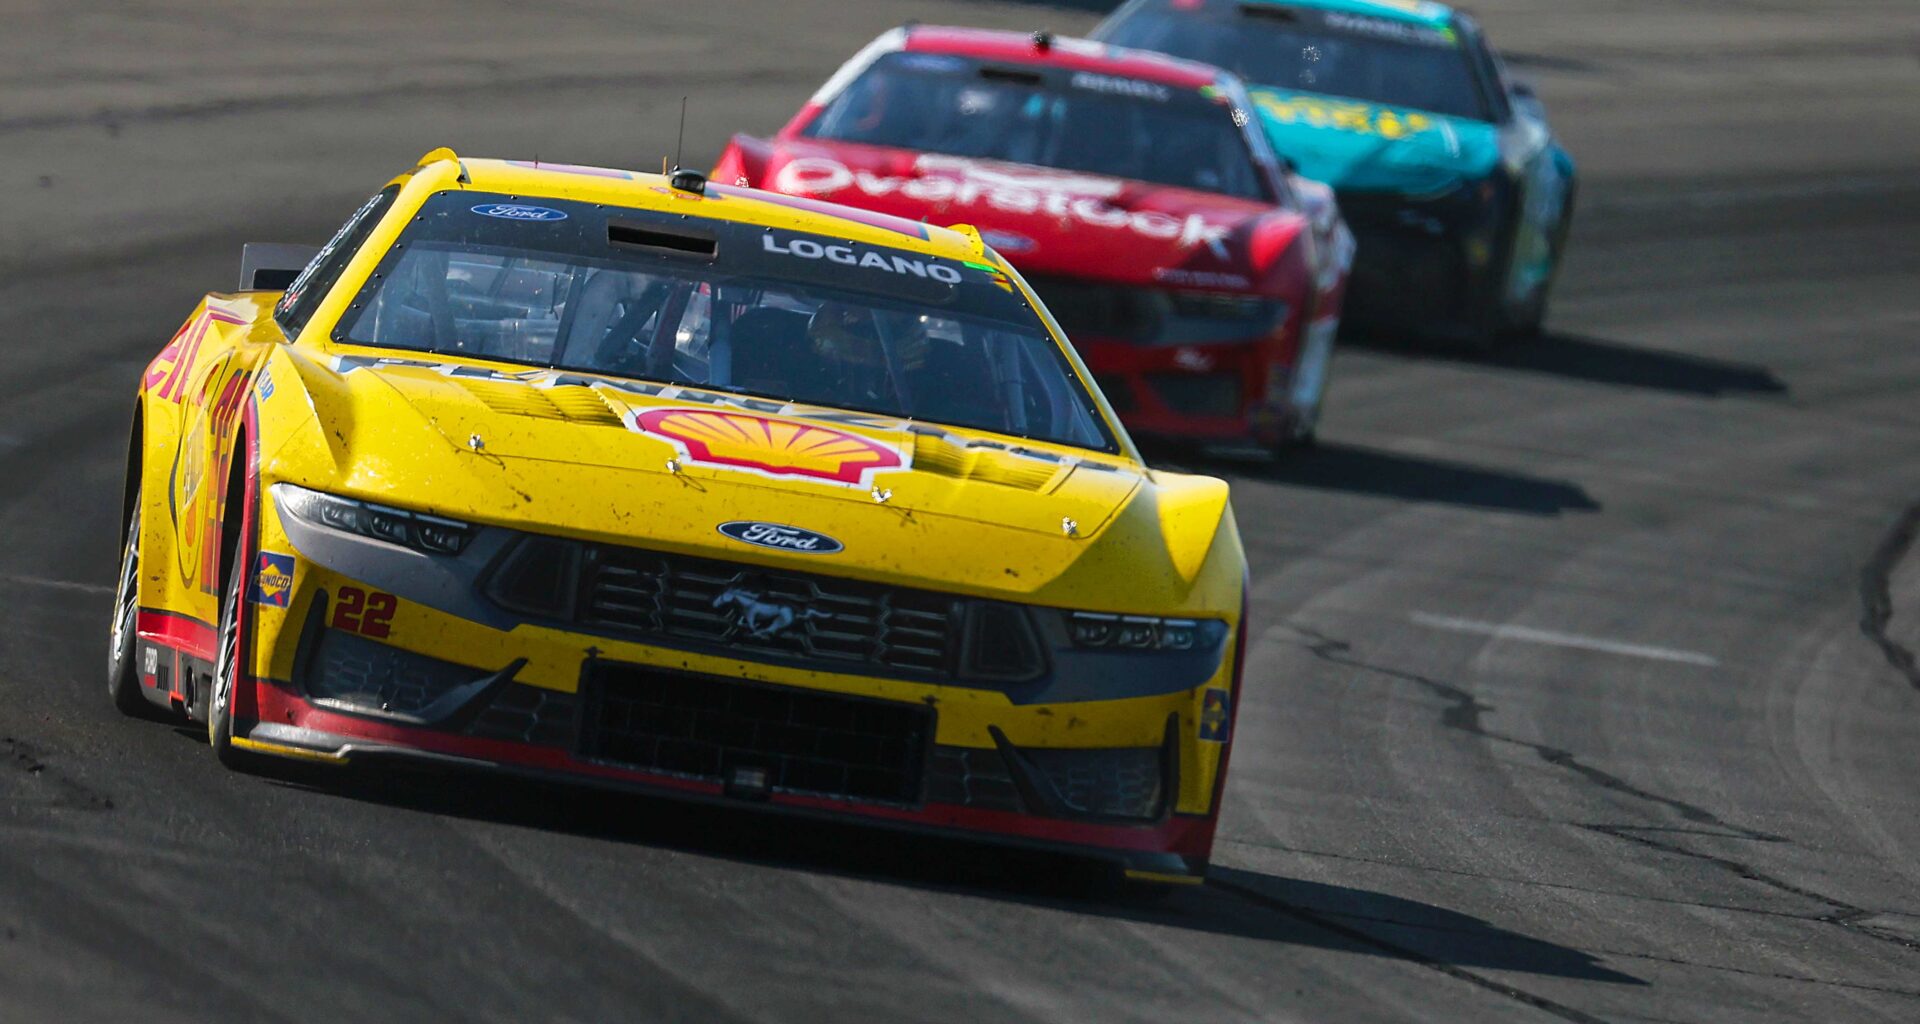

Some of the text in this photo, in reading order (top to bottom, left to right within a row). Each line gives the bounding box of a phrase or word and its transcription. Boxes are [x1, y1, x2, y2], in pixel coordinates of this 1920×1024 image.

[489, 204, 549, 218] Ford
[777, 157, 1230, 260] Overstock
[762, 234, 962, 284] LOGANO
[742, 523, 819, 550] Ford
[332, 585, 398, 640] 22
